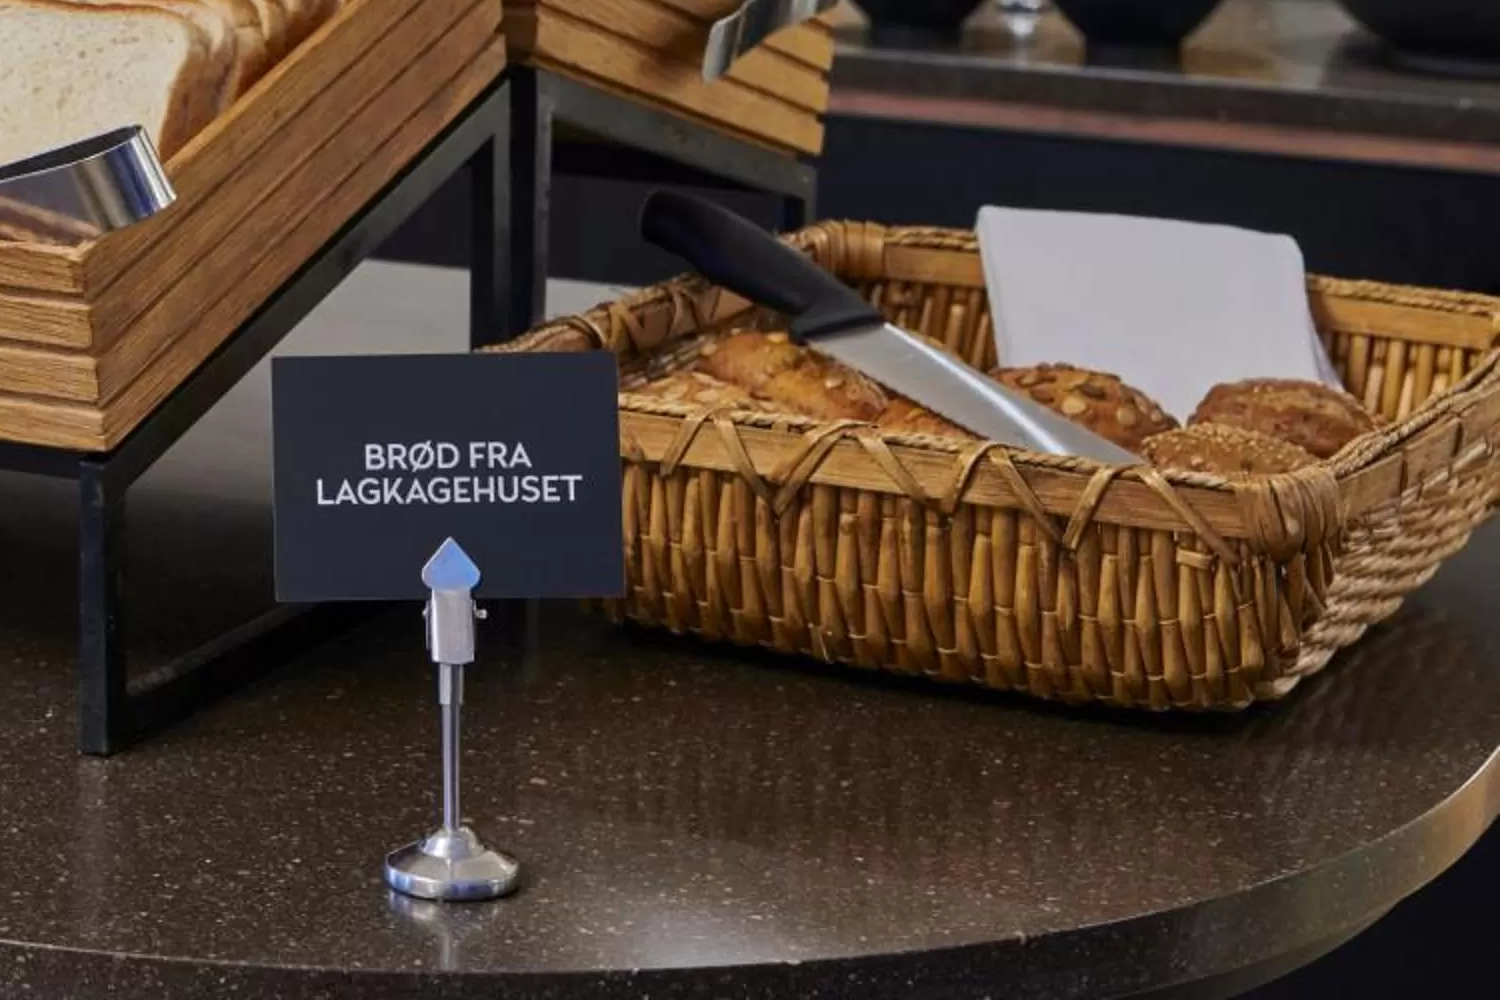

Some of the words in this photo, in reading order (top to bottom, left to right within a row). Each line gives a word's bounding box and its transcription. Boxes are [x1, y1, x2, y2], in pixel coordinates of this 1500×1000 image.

[365, 440, 460, 472] BRØD
[469, 442, 532, 468] FRA
[316, 475, 583, 505] LAGKAGEHUSET
